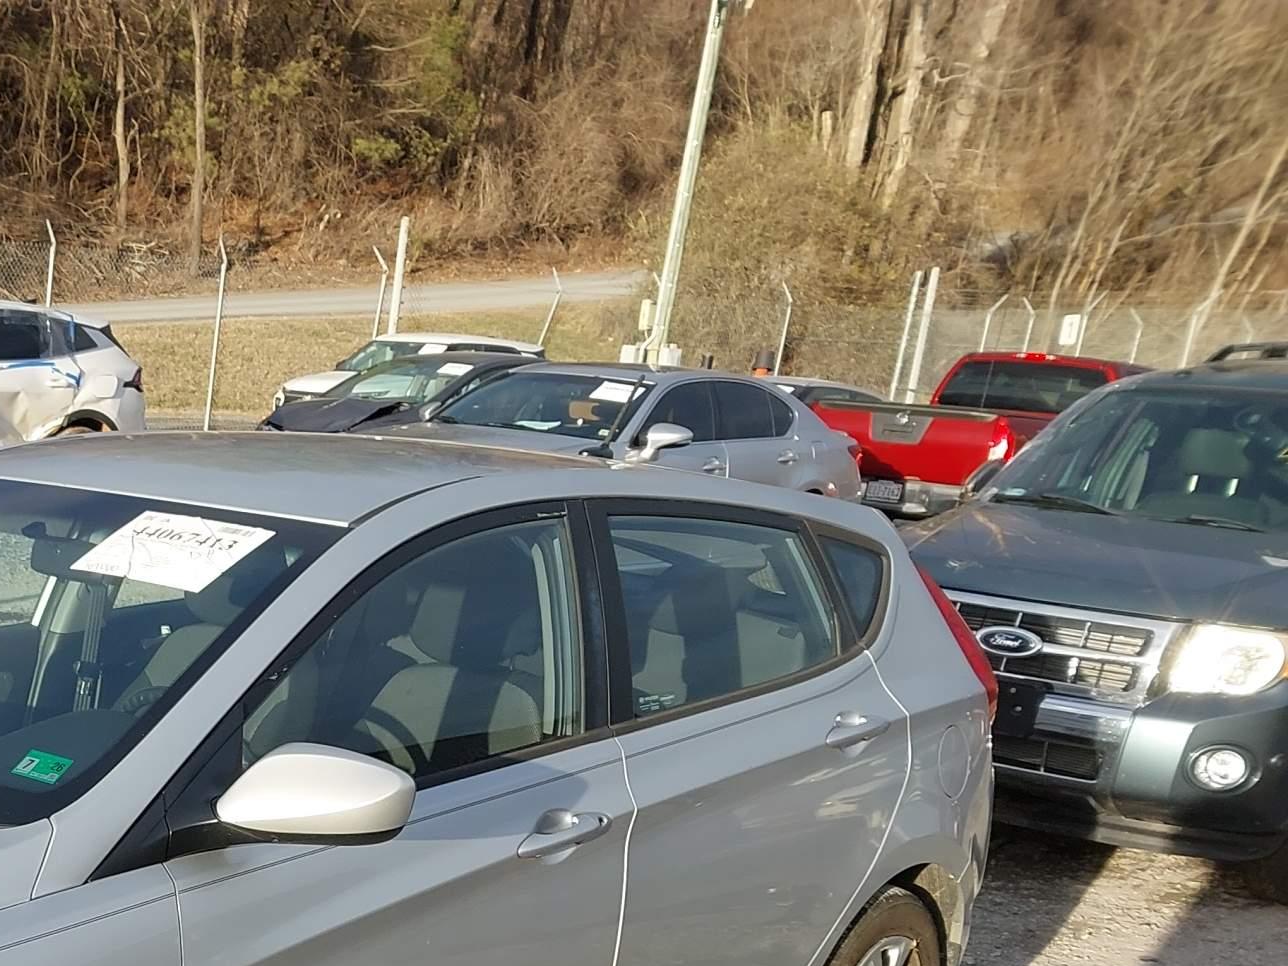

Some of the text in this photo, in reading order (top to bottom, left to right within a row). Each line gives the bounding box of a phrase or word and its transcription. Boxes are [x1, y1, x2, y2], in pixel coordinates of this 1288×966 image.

[132, 526, 239, 550] 44067413
[990, 633, 1023, 648] Ford
[22, 758, 36, 770] 7
[50, 761, 66, 772] 26
